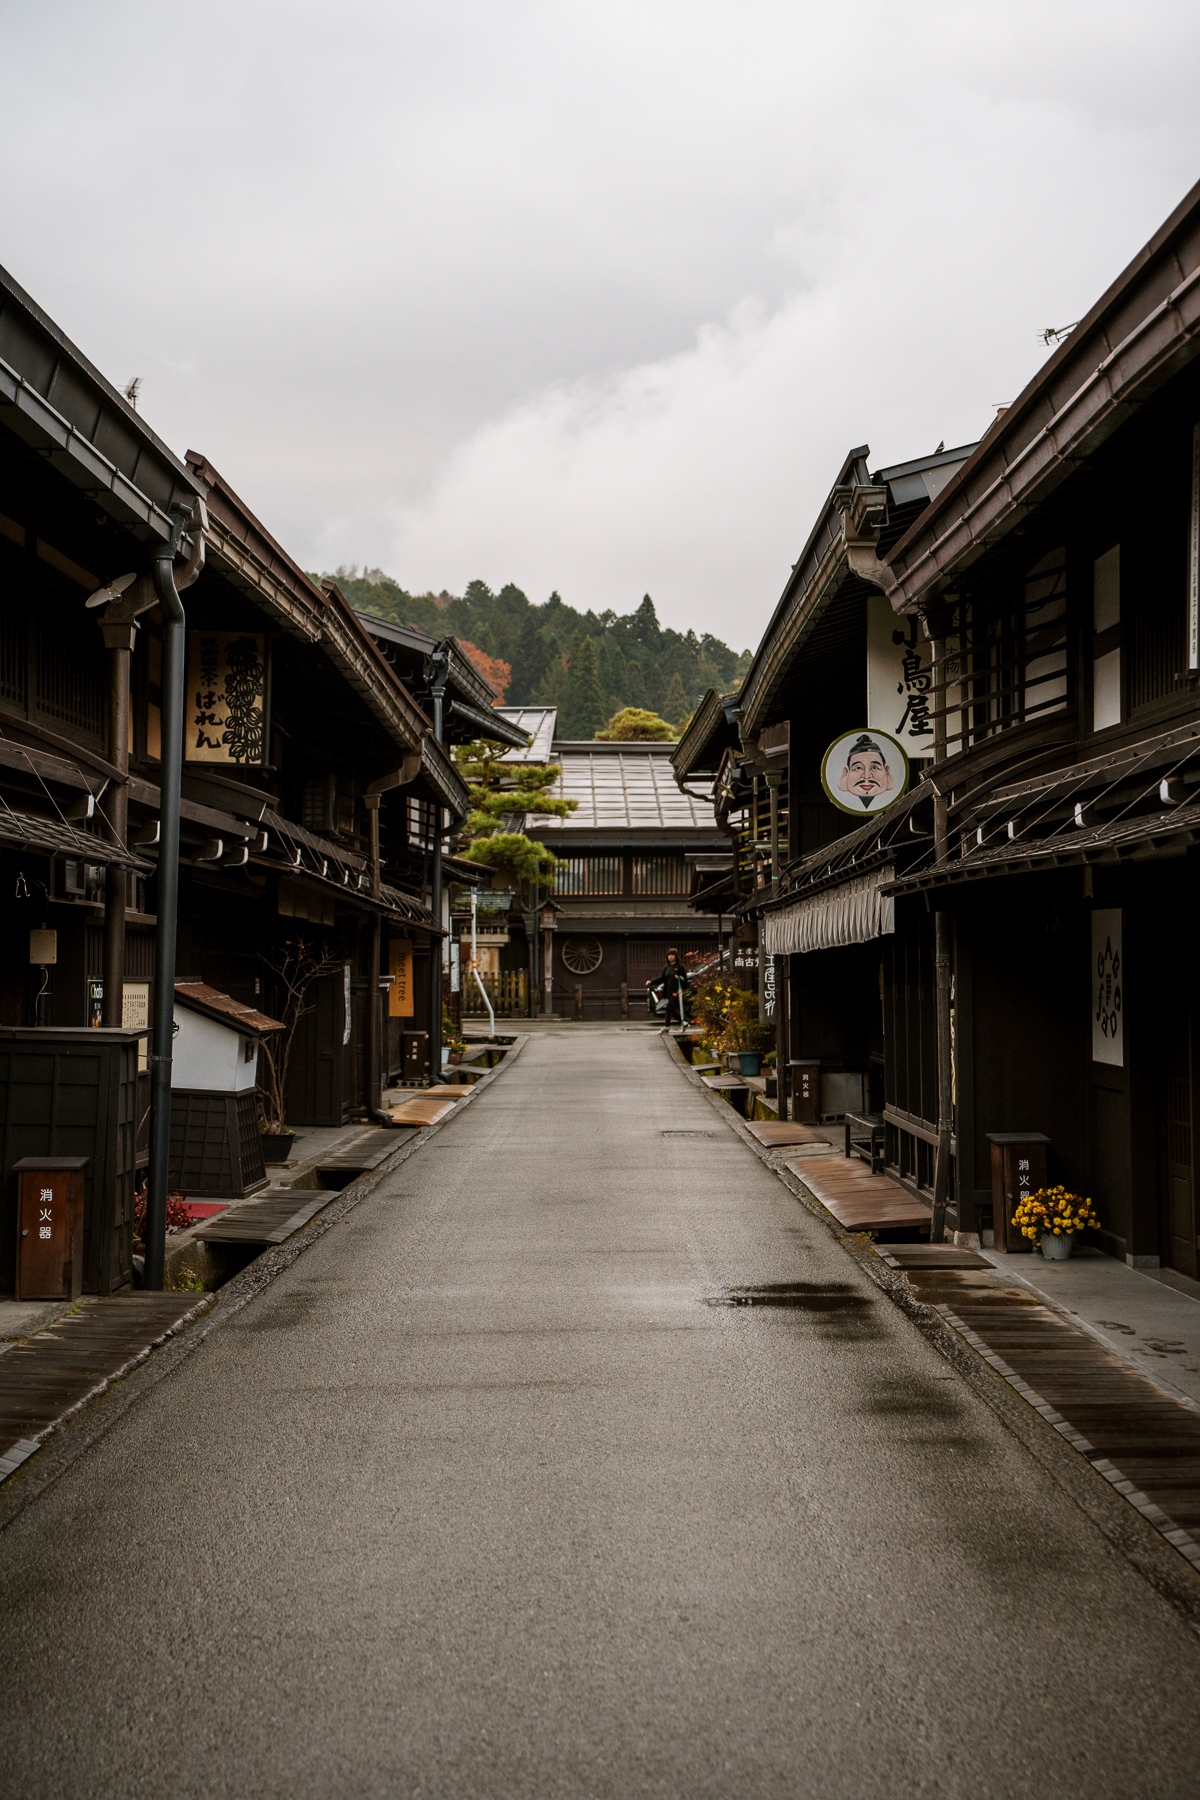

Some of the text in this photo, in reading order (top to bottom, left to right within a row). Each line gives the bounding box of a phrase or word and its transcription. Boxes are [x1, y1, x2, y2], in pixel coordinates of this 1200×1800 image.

[892, 613, 934, 737] 小鳥屋
[194, 691, 225, 749] ばれん
[398, 952, 406, 1002] meet tree
[39, 1188, 53, 1239] 消火器
